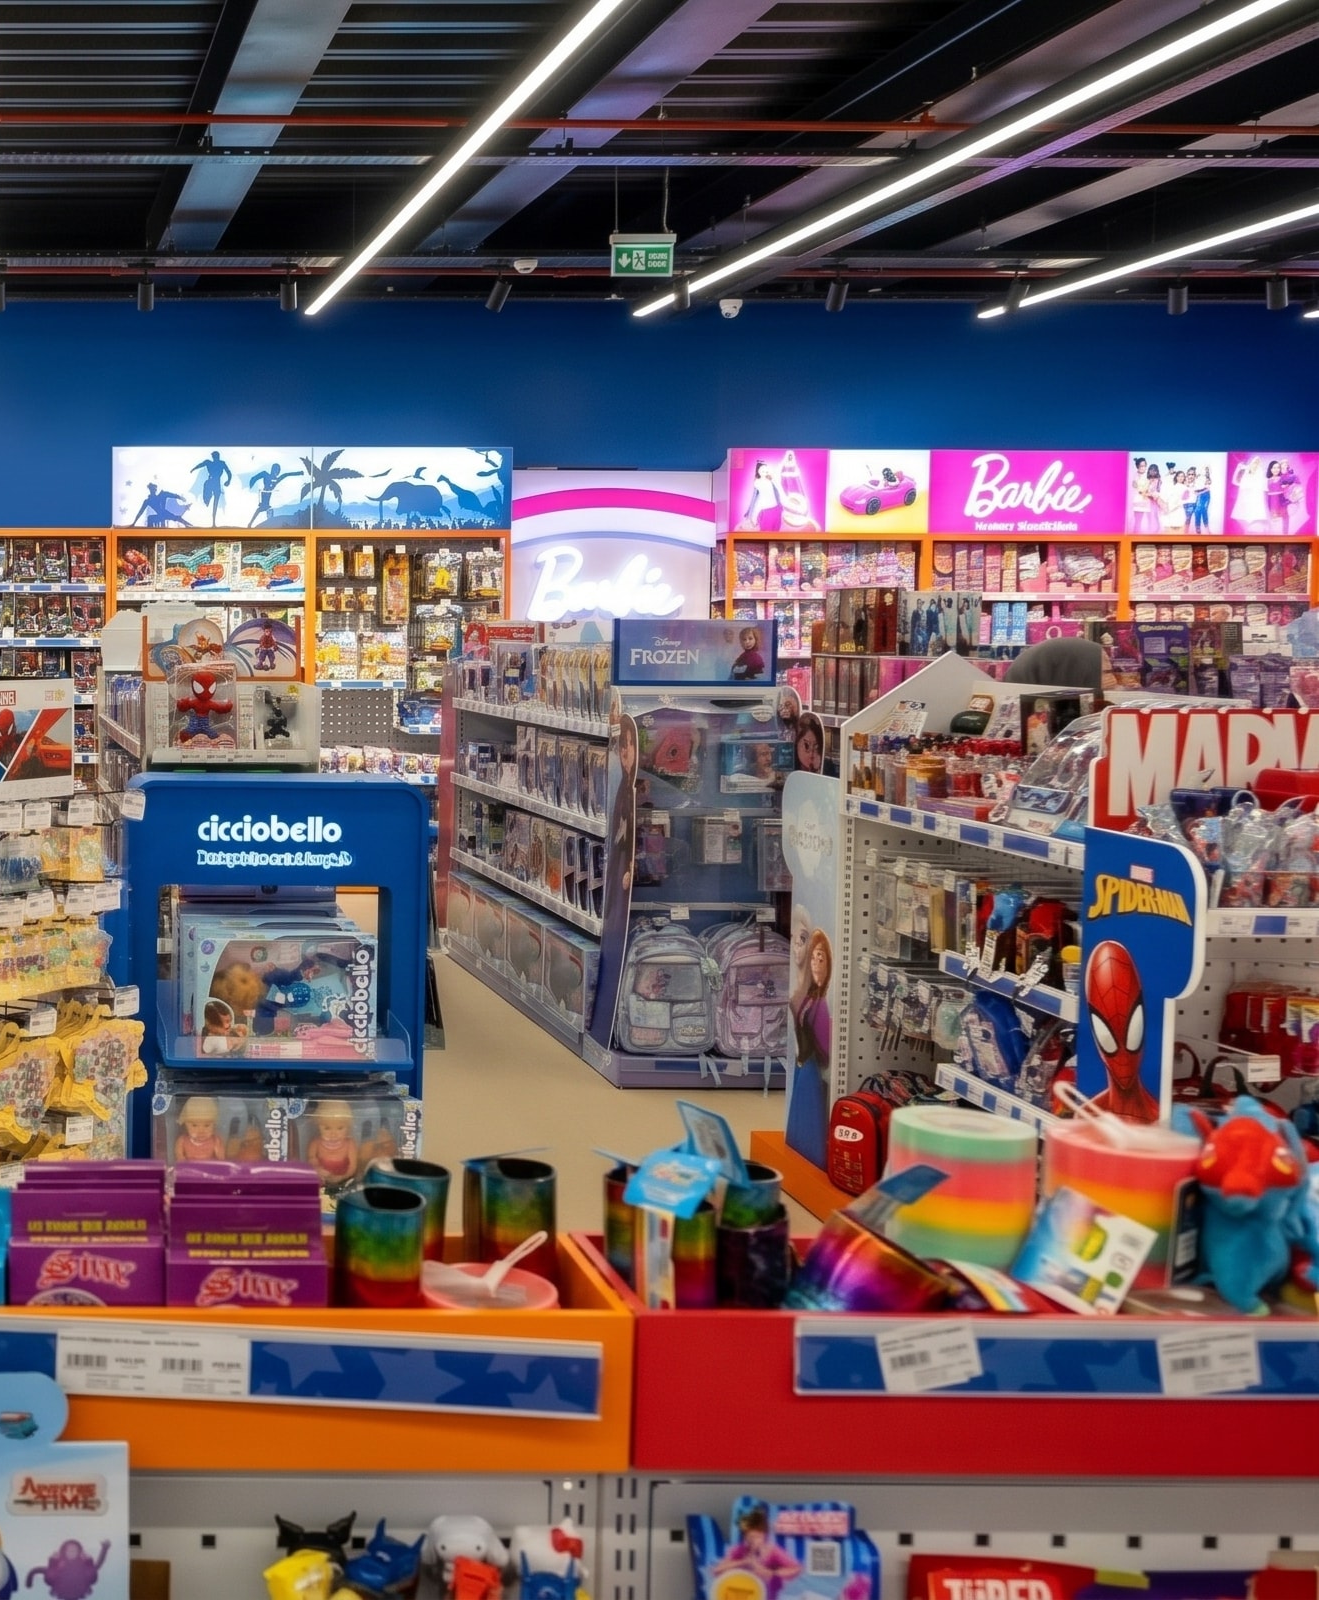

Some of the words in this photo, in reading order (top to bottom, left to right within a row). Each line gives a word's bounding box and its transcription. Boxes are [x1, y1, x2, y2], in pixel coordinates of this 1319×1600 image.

[964, 453, 1093, 518] Barbie
[630, 648, 700, 666] FROZEN
[197, 815, 342, 843] cicciobello
